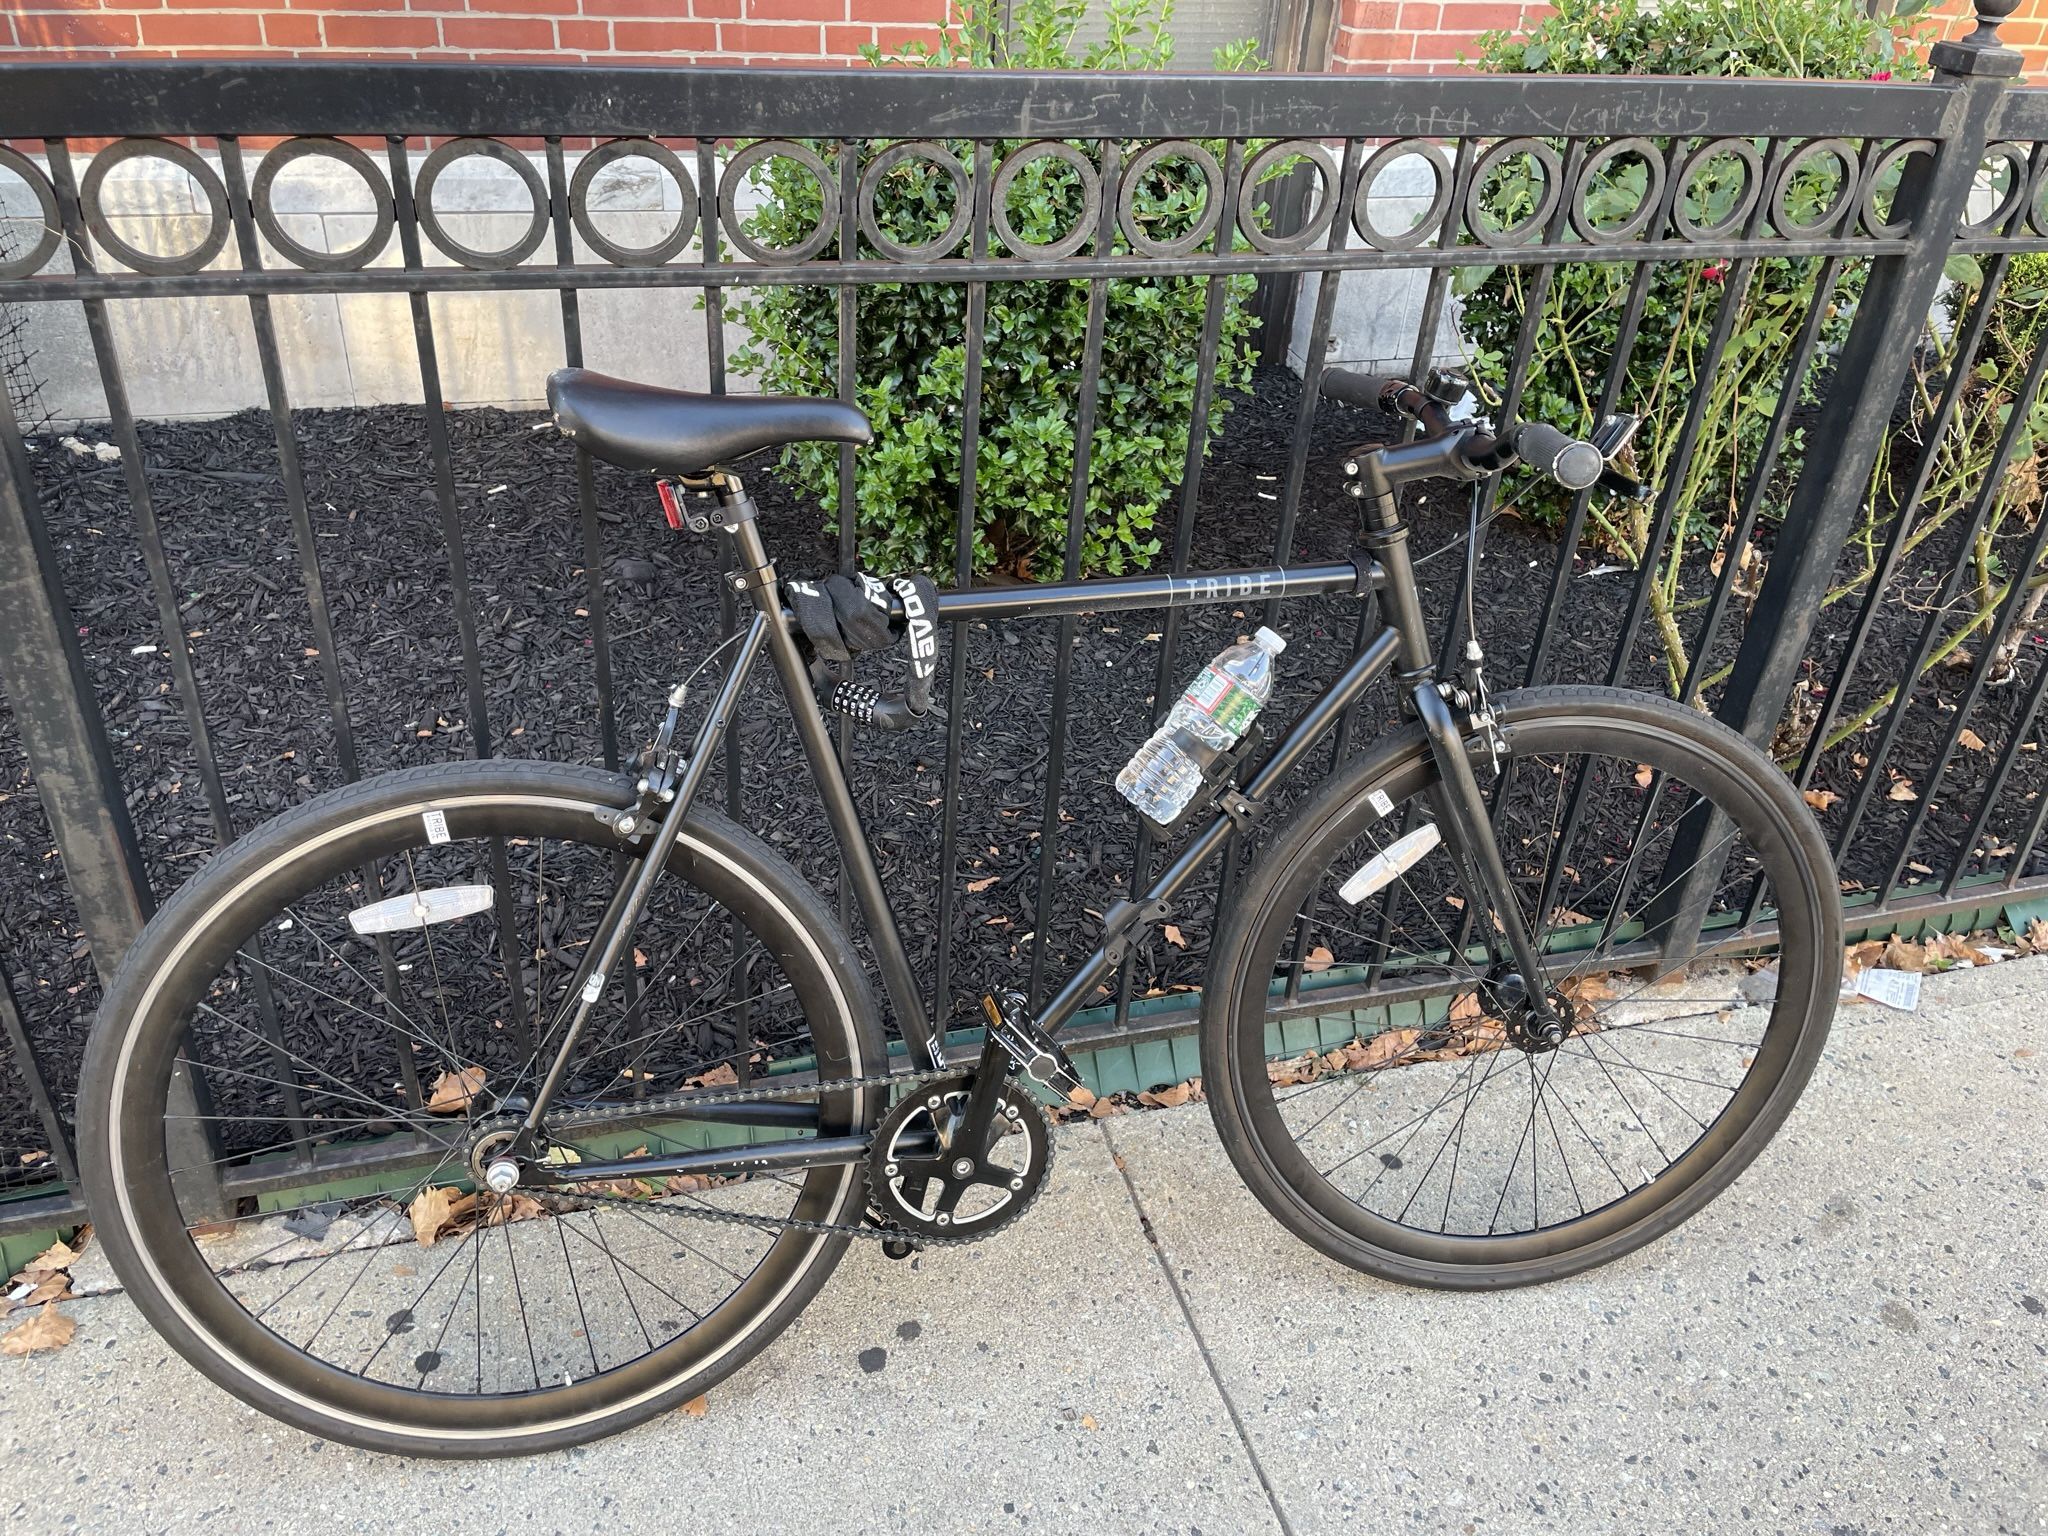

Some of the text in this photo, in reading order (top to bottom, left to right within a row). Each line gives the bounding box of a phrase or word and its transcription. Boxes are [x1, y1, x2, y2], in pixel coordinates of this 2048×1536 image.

[1186, 574, 1271, 600] TRIBE
[1373, 790, 1391, 811] TRIBE
[431, 812, 447, 839] TRIBE
